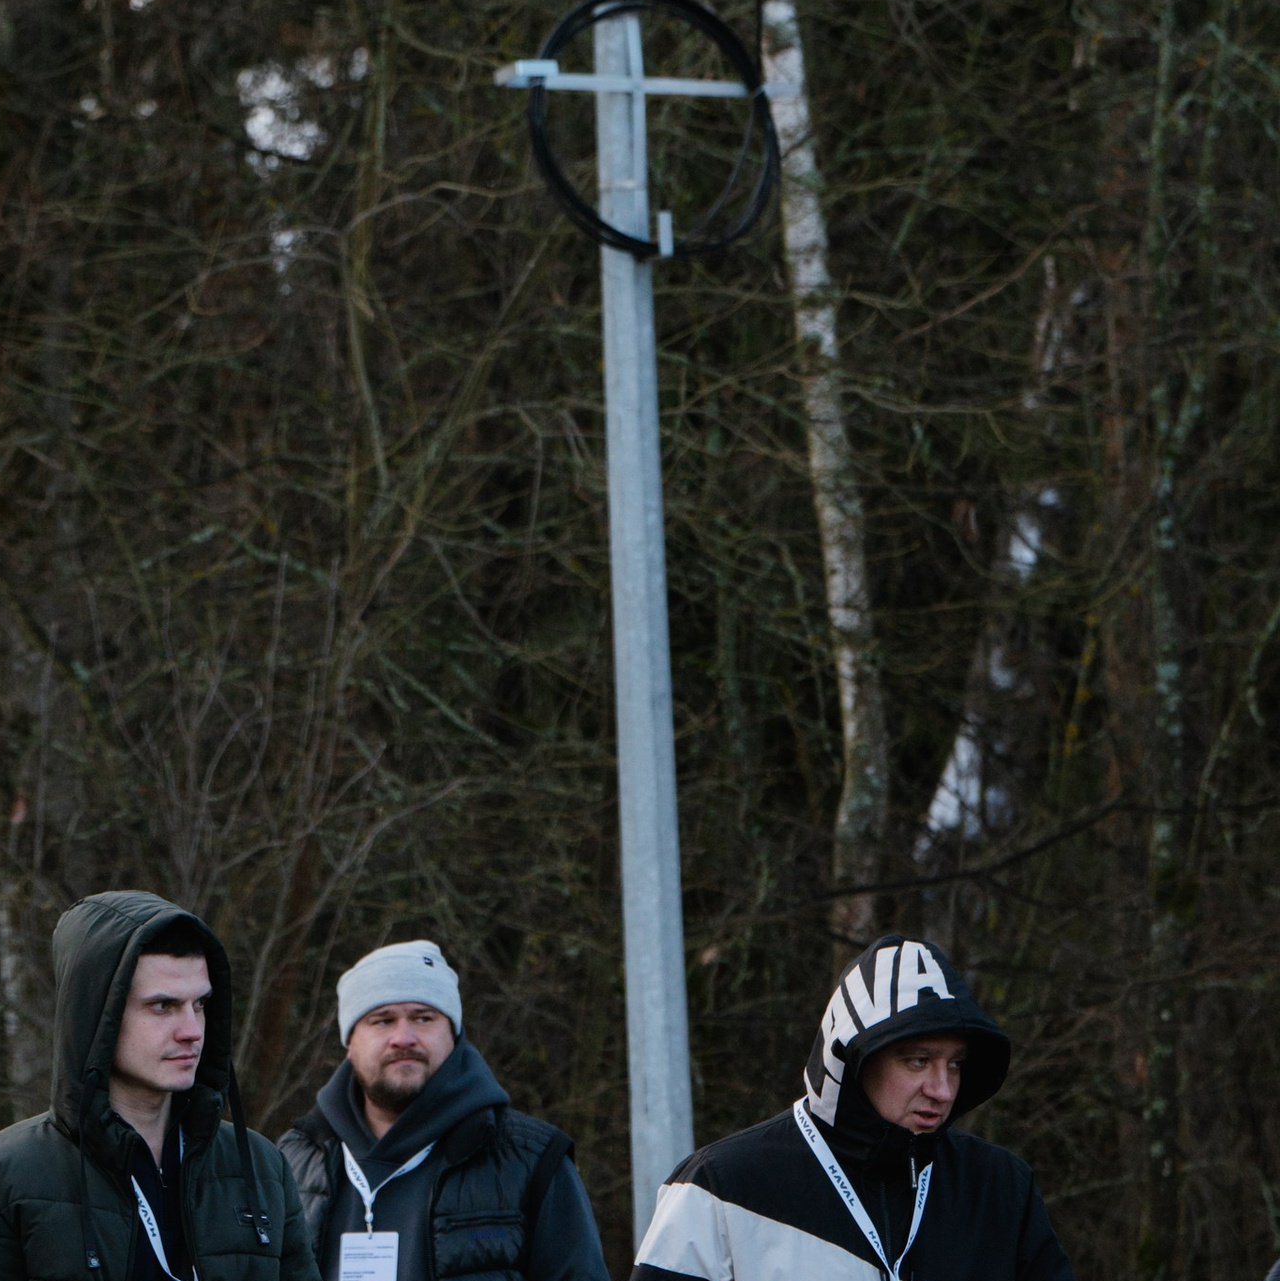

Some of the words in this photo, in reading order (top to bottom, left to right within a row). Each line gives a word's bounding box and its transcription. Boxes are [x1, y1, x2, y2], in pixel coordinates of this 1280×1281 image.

[796, 1108, 816, 1143] HAVAL
[829, 1164, 855, 1207] HAVAL
[917, 1170, 928, 1209] HAVAL
